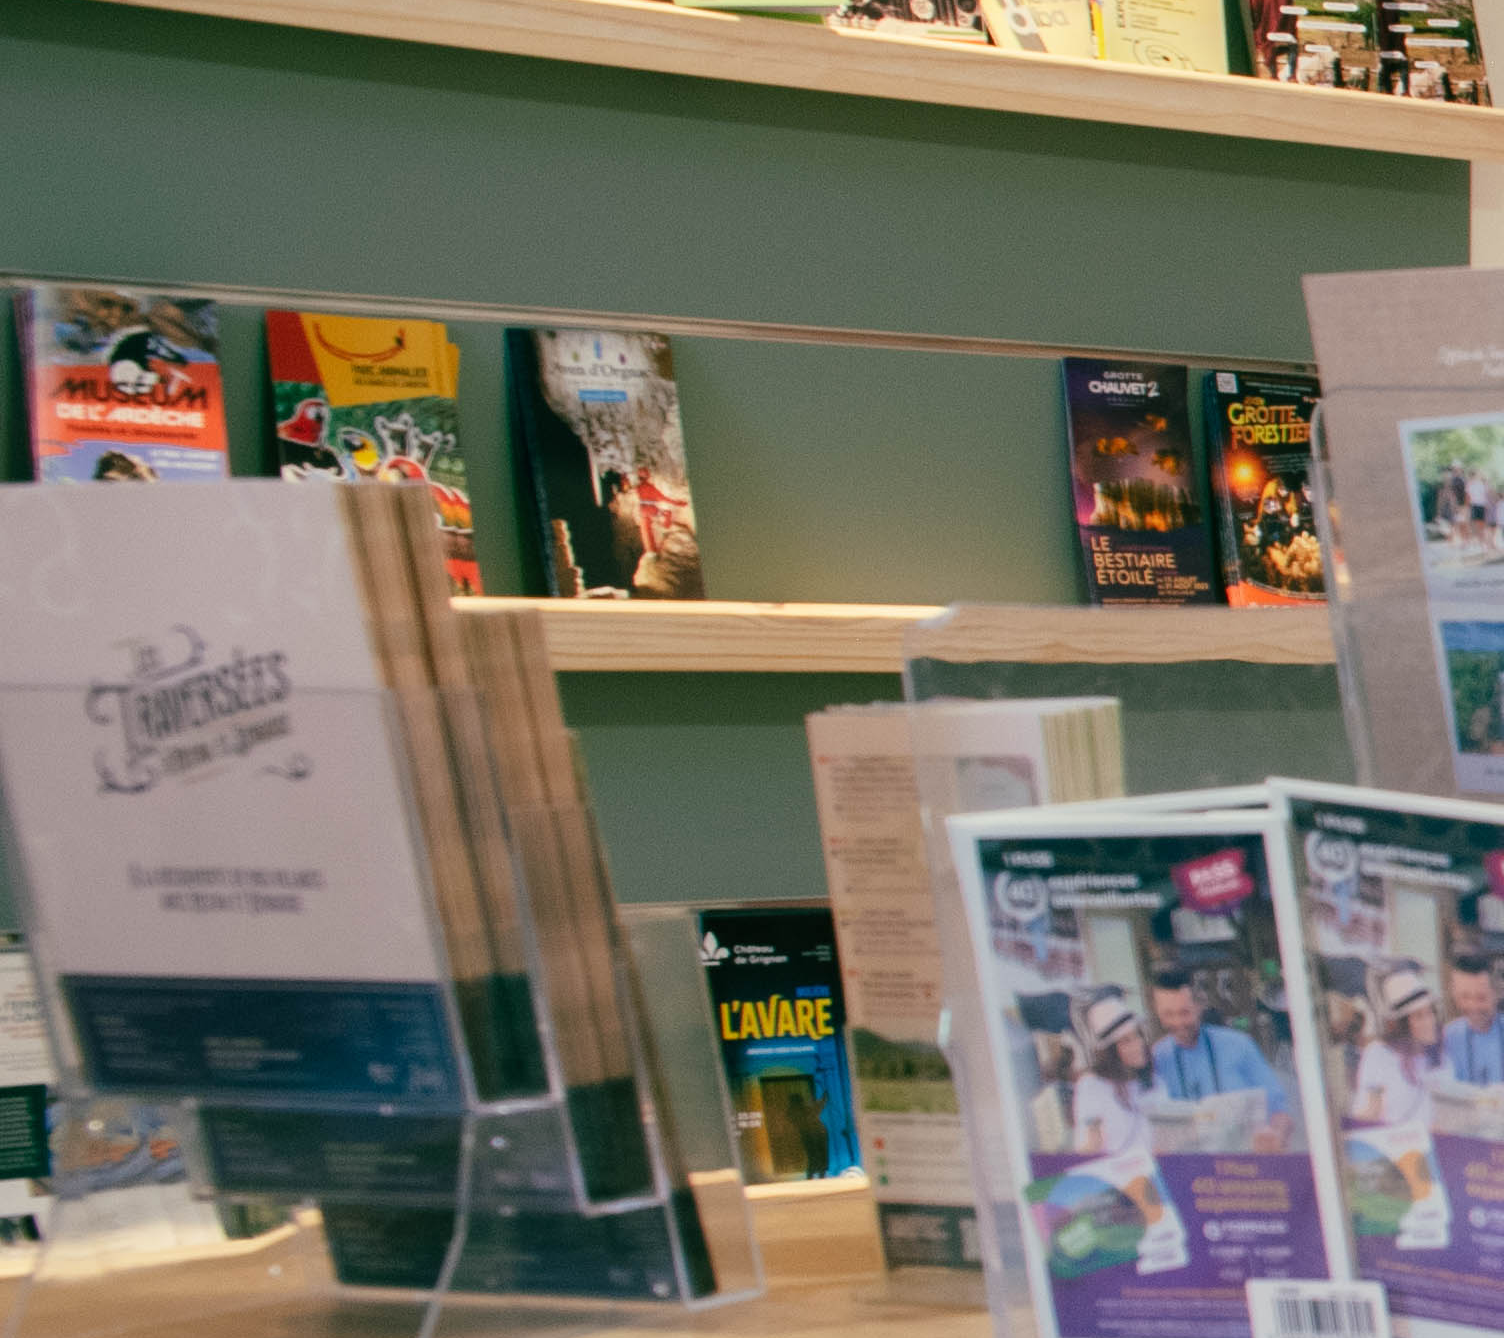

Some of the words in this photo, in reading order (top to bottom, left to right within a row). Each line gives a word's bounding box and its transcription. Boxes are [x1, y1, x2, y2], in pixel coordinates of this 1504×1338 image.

[1103, 370, 1144, 382] GROTTE
[1088, 380, 1147, 397] CHAUVET
[1147, 380, 1160, 398] 2
[1227, 401, 1298, 425] GROTTE
[1090, 535, 1111, 553] LE
[1093, 552, 1178, 570] BESTIAIRE
[720, 994, 834, 1041] L'AVARE
